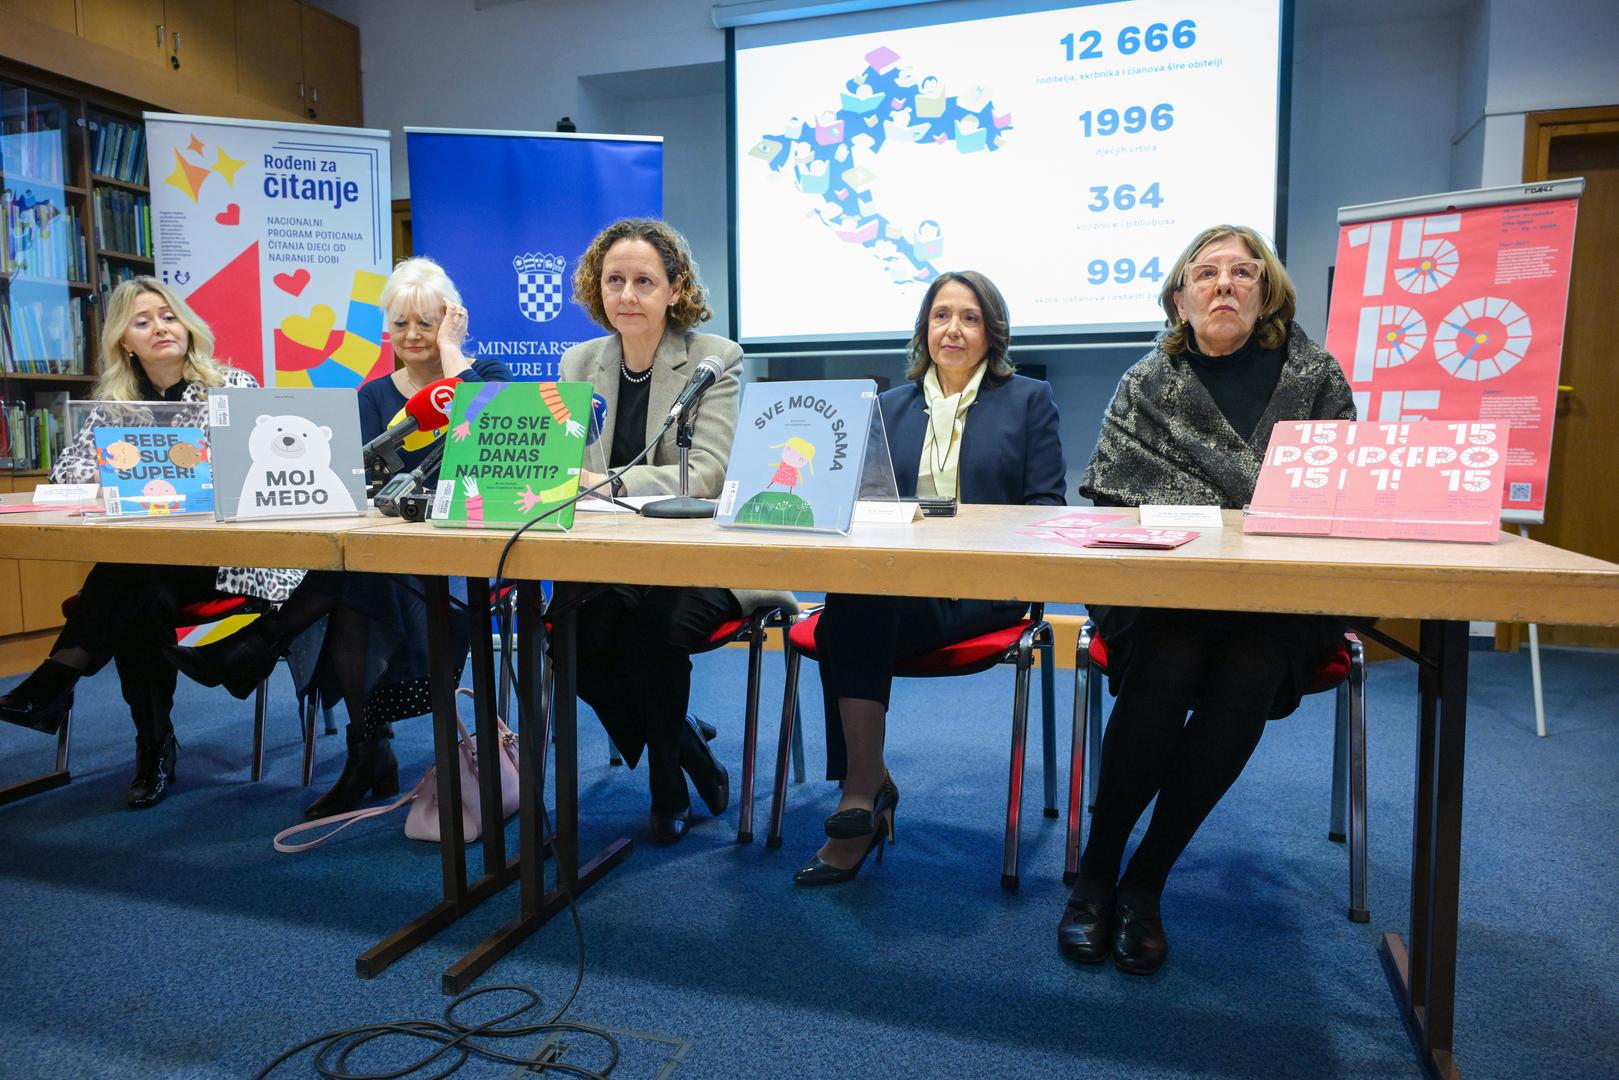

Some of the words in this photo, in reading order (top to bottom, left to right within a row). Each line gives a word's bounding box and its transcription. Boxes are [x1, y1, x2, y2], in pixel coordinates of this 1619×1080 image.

[1060, 30, 1103, 61] 12
[1117, 19, 1197, 55] 666
[1080, 70, 1120, 80] skrbnika
[1168, 62, 1185, 71] šire
[1188, 58, 1223, 69] obitelji
[1079, 103, 1174, 137] 1996
[264, 154, 316, 171] Rođeni
[320, 160, 337, 172] za
[1087, 182, 1164, 212] 364
[267, 216, 323, 227] NACIONALNI
[268, 229, 312, 239] PROGRAM
[315, 230, 363, 241] POTICANJA
[268, 240, 304, 251] ČITANJA
[307, 242, 331, 252] DJECI
[333, 243, 346, 252] OD
[1348, 213, 1462, 296] 15
[269, 253, 315, 264] NAJRANIJE
[318, 254, 340, 264] DOBI
[1087, 256, 1164, 285] 994
[478, 341, 579, 355] MINISTARS
[1352, 297, 1532, 382] PO
[506, 362, 543, 376] URE
[479, 412, 512, 429] ŠTO
[516, 416, 550, 429] SVE
[124, 434, 178, 447] BEBE
[478, 432, 546, 446] MORAM
[754, 401, 784, 430] SVE
[788, 395, 837, 419] MOGU
[829, 419, 848, 471] SAMA
[1295, 423, 1338, 444] 15
[1448, 423, 1496, 445] 15
[139, 450, 169, 463] SU
[479, 448, 539, 462] DANAS
[1273, 445, 1338, 466] PO
[1425, 446, 1499, 468] PO
[118, 466, 195, 480] SUPER!
[266, 470, 315, 487] MOJ
[455, 464, 559, 479] NAPRAVITI?
[1285, 467, 1329, 488] 15
[1440, 469, 1492, 492] 15
[255, 489, 329, 507] MEDO
